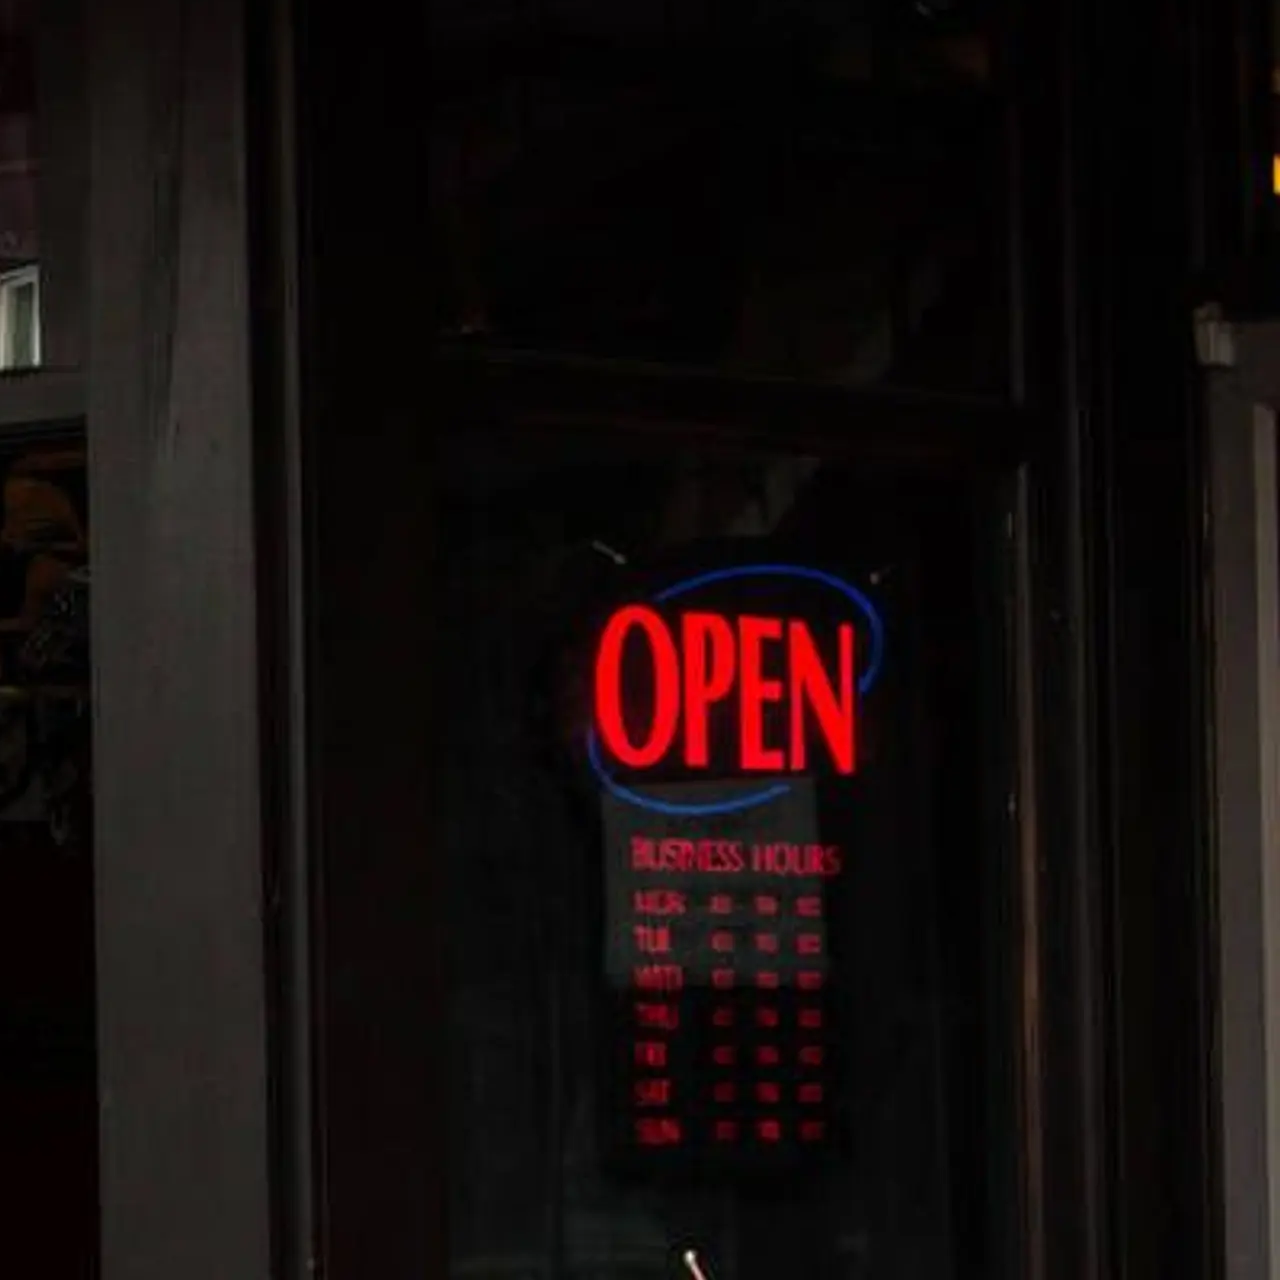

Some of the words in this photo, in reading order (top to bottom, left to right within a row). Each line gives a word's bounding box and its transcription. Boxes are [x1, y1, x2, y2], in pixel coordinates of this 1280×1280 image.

[595, 603, 854, 774] OPEN
[631, 836, 742, 872] BUSINESS
[751, 842, 840, 876] HOURS
